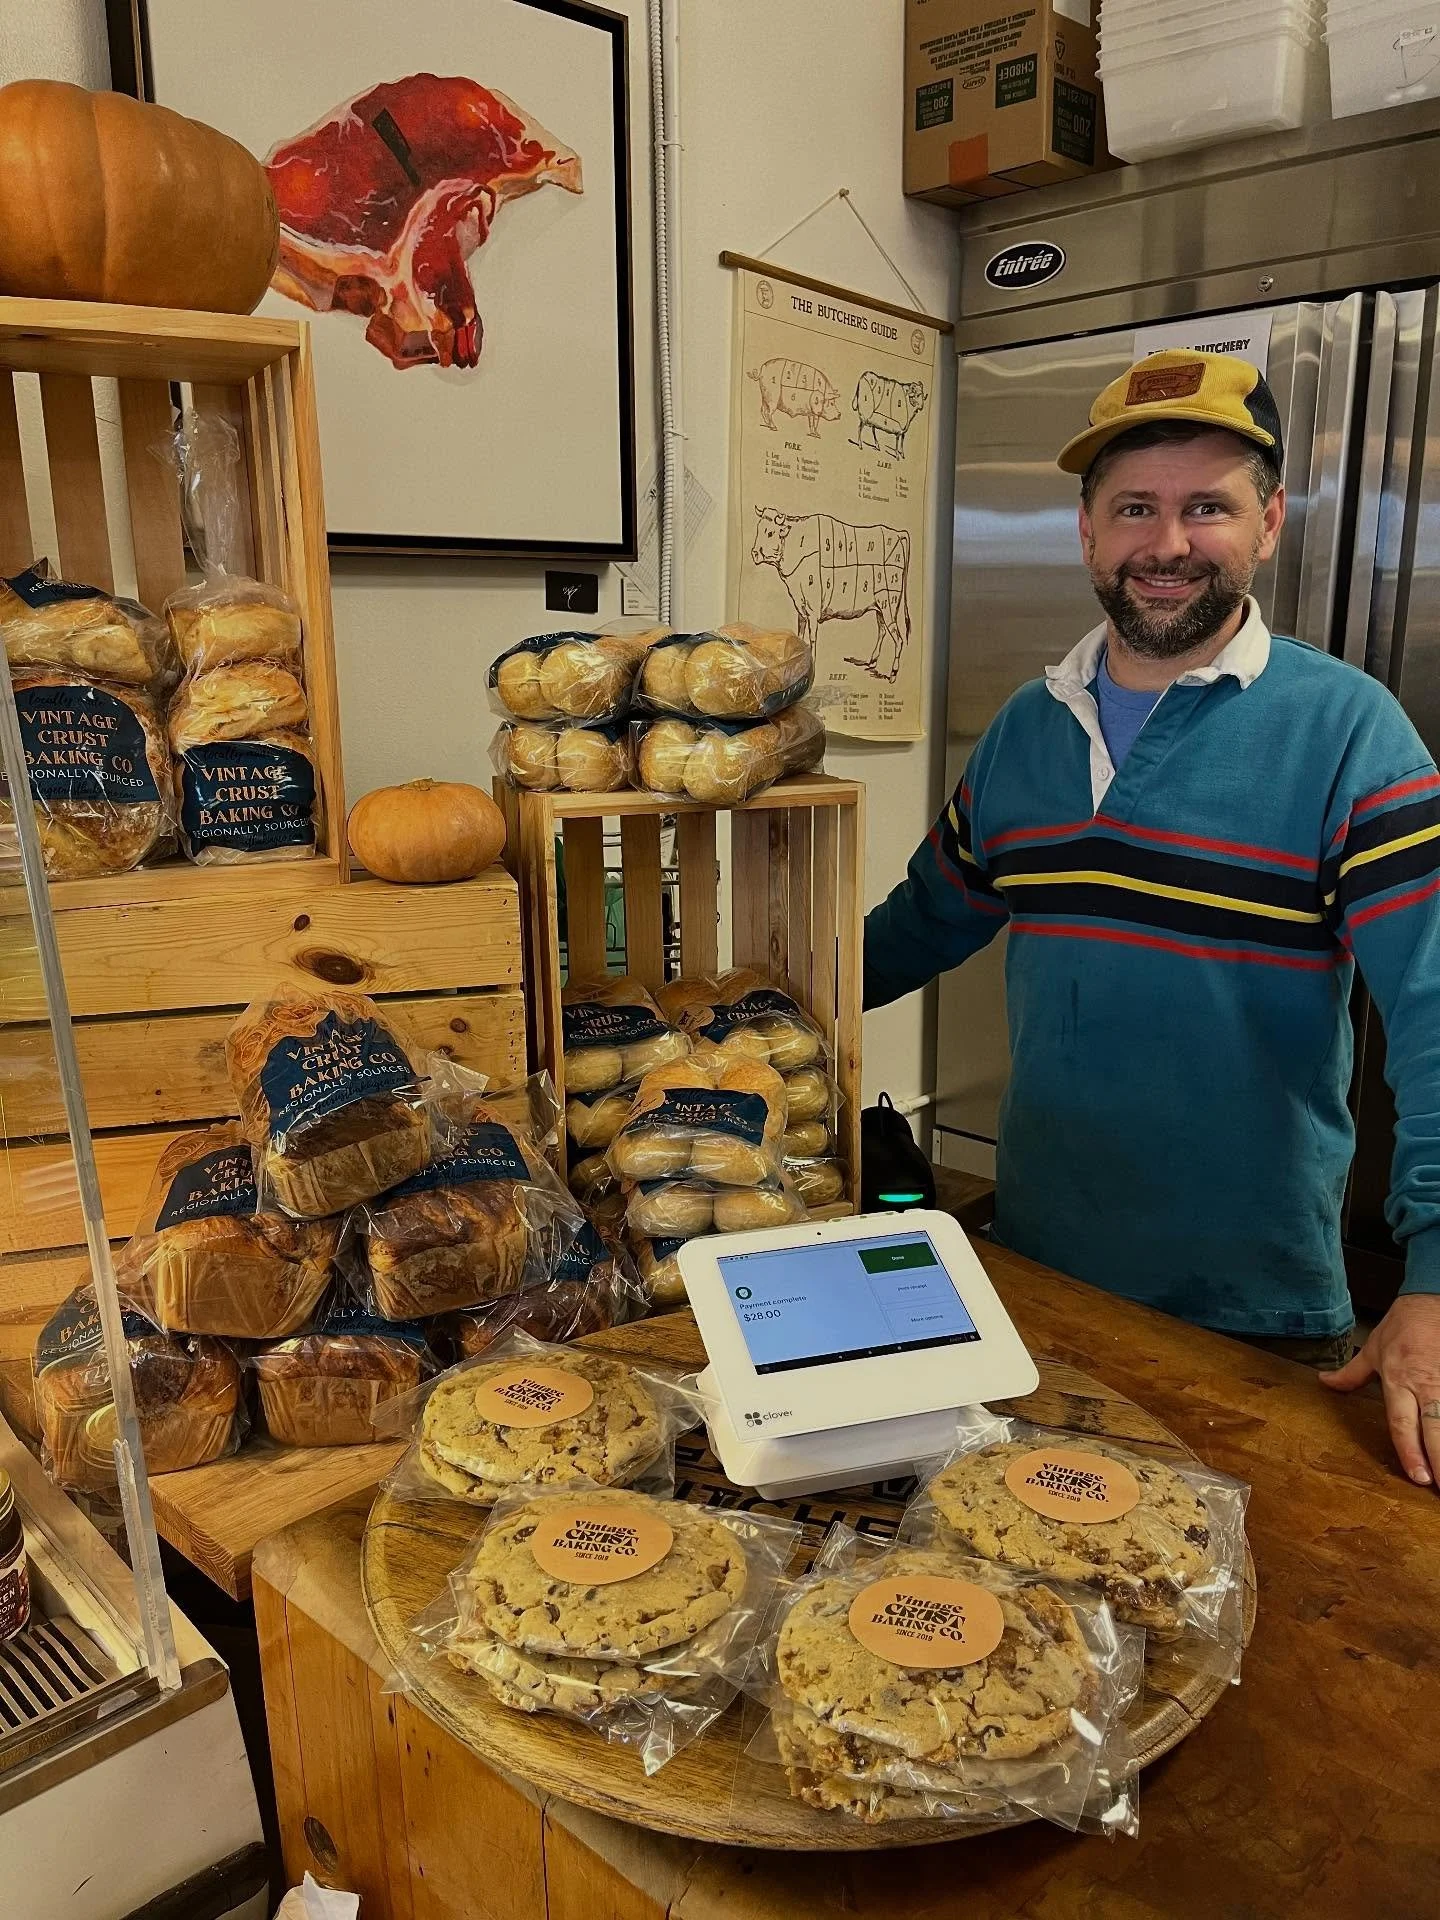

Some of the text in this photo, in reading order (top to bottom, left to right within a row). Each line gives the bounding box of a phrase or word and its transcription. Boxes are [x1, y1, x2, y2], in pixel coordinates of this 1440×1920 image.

[998, 60, 1034, 81] CH8DEF
[933, 96, 950, 109] 200
[994, 250, 1054, 277] Entrée
[791, 296, 898, 341] THE BUTCHER'S GUIDE
[1194, 338, 1251, 353] BUTCHERY
[21, 711, 117, 730] VINTAGE
[37, 730, 109, 747] CRUST
[23, 750, 134, 775] BAKING CO
[201, 765, 289, 782] VINTAGE
[215, 784, 280, 802] CRUST
[199, 804, 299, 826] BAKING CO
[289, 1056, 364, 1100] BAKING
[368, 1052, 397, 1065] CO
[278, 1073, 352, 1118] REGIONALLY
[356, 1065, 410, 1080] SOURCED
[477, 1148, 504, 1157] CO
[204, 1157, 249, 1174] VINT
[211, 1167, 252, 1183] CRU
[188, 1177, 254, 1202] BAKIN
[170, 1188, 253, 1218] REGIONALLY
[739, 1294, 807, 1312] Payment complete
[743, 1309, 782, 1323] $28.00
[59, 1311, 102, 1344] BAK
[494, 1387, 536, 1406] BAKING
[507, 1383, 561, 1407] CRUST
[521, 1378, 565, 1398] Vintage
[763, 1410, 792, 1421] clover
[1035, 1470, 1107, 1492] CRUST
[1042, 1462, 1104, 1482] Vintage
[1025, 1477, 1109, 1503] BAKING CO.
[1048, 1489, 1066, 1498] SINCE
[575, 1519, 637, 1536] Vintage
[565, 1528, 640, 1547] CRUST
[552, 1538, 639, 1557] BAKING CO.
[895, 1593, 964, 1614] Vintage
[884, 1603, 967, 1630] CRUST
[871, 1613, 966, 1644] BAKING CO.
[895, 1628, 934, 1642] SINCE 2019
